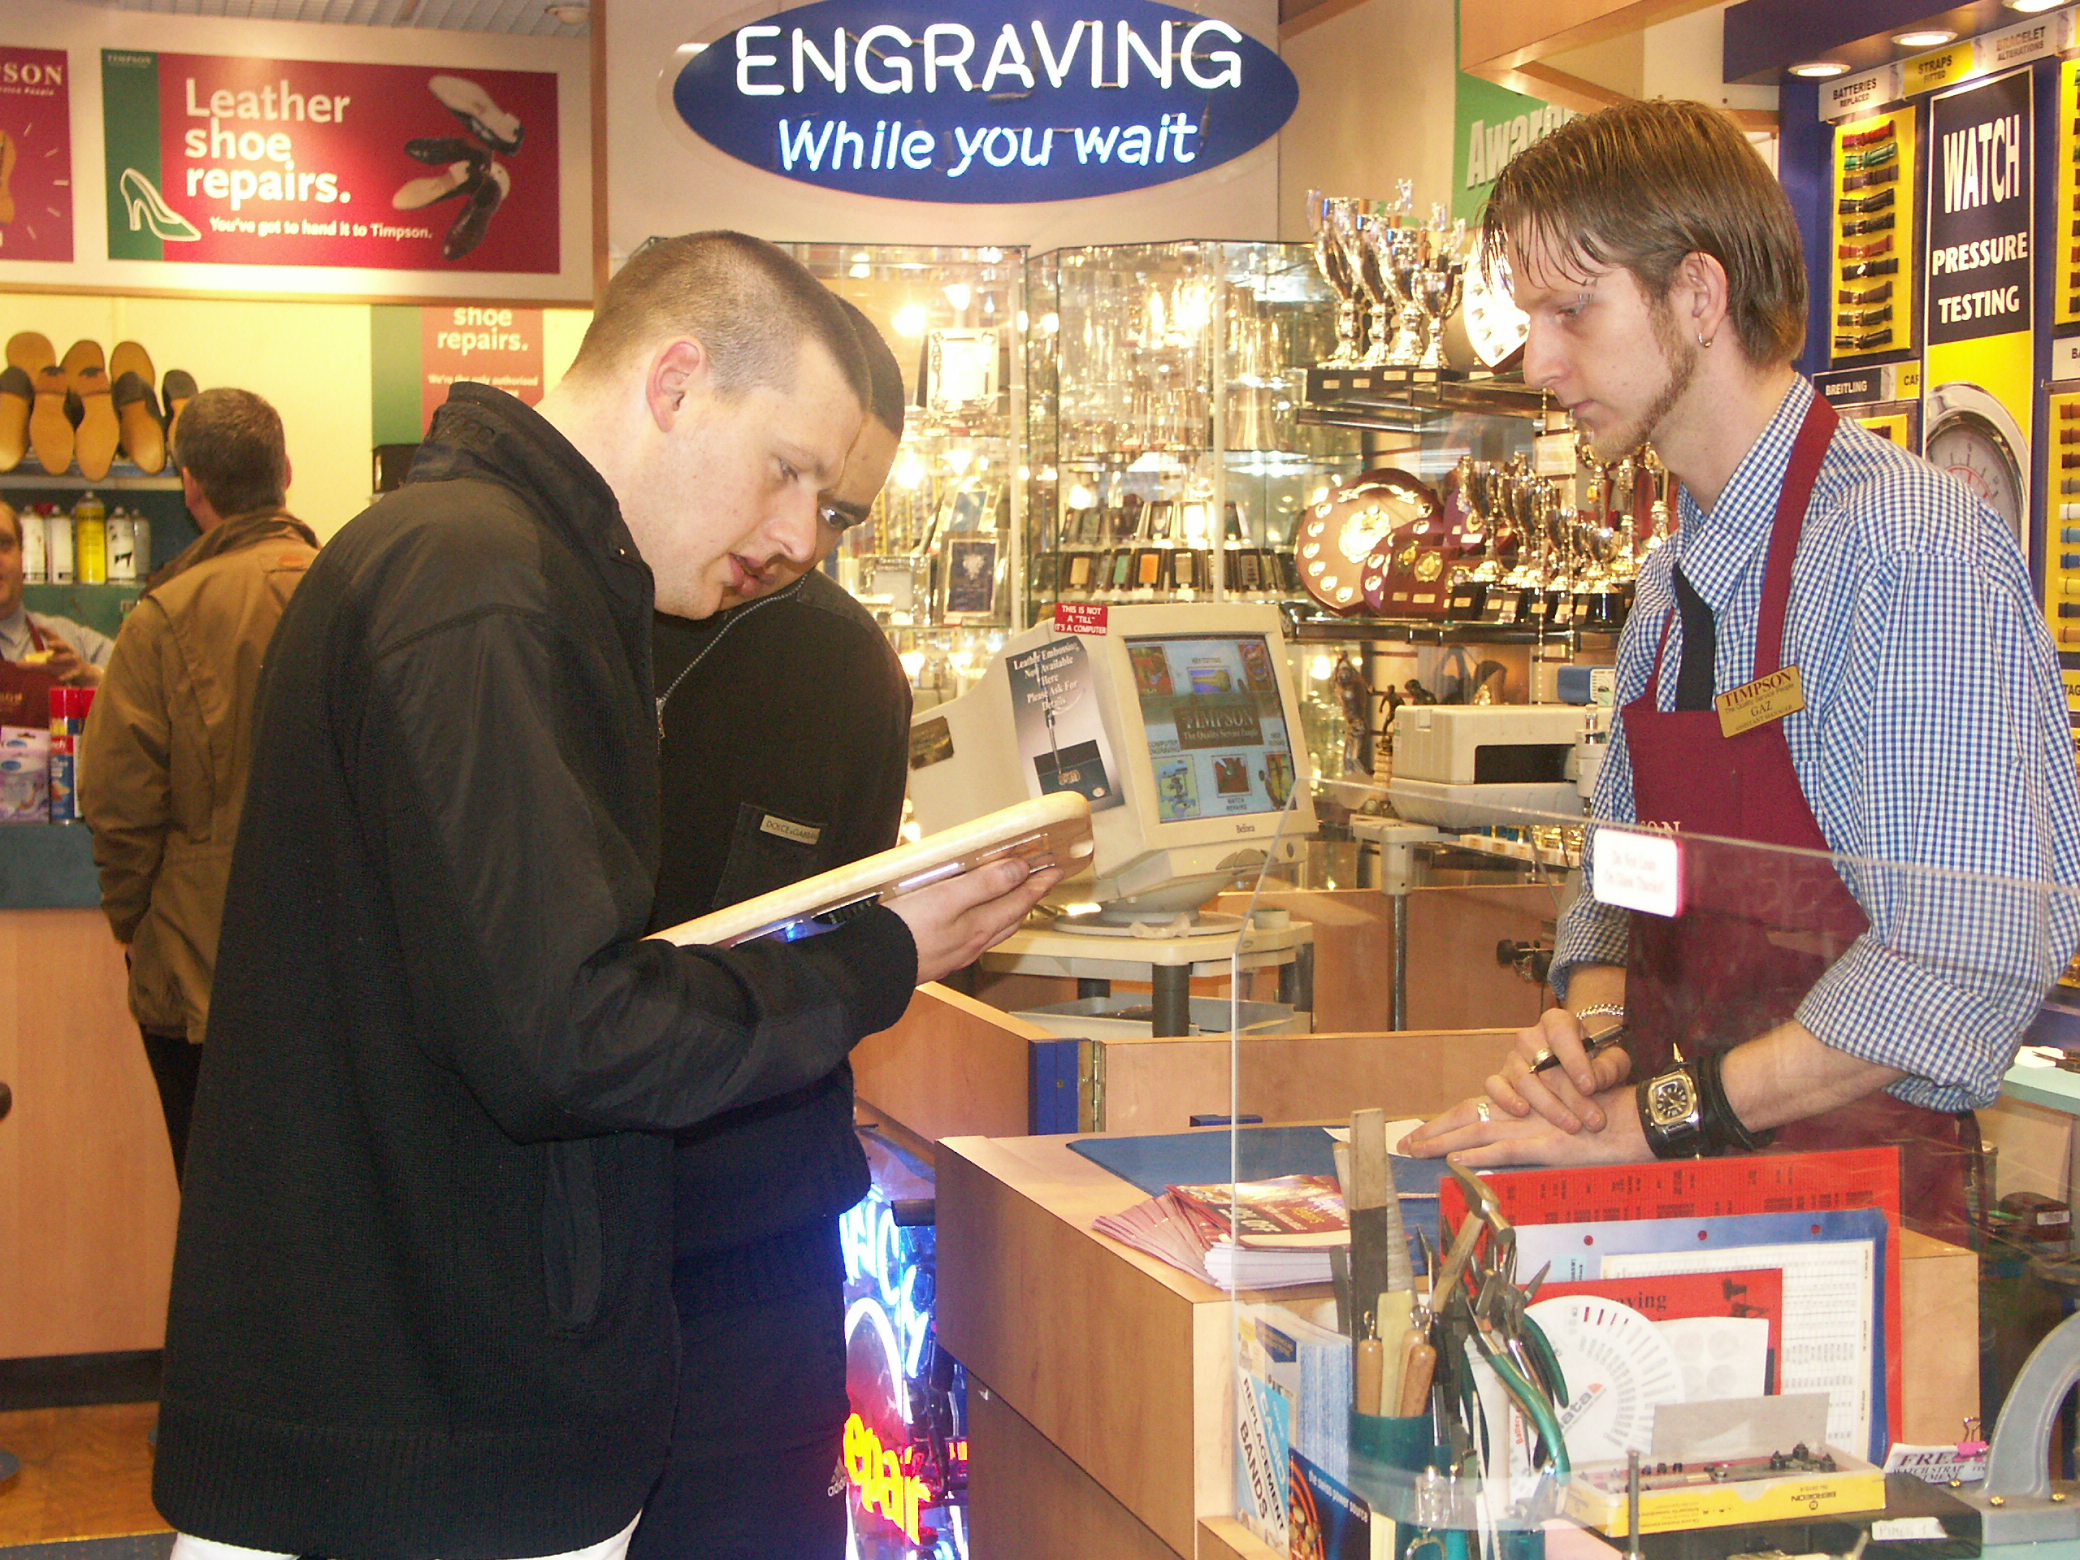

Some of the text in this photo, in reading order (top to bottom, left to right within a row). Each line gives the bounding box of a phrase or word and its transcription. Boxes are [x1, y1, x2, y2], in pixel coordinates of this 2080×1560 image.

[1997, 26, 2046, 51] BRACELET
[736, 20, 1242, 95] ENGRAVING
[1918, 55, 1952, 75] STRAPS
[2, 61, 62, 85] SON
[186, 78, 351, 123] Leather
[1833, 78, 1877, 100] BATTERIES
[1840, 93, 1869, 108] REPLACED
[185, 117, 292, 162] shoe
[779, 113, 1197, 177] While you wait
[1943, 114, 2020, 214] WATCH
[186, 160, 351, 211] repairs.
[209, 216, 433, 240] You've got to hand it to Timpson.
[1932, 231, 2028, 276] PRESSURE
[1938, 285, 2020, 324] TESTING
[453, 307, 513, 327] shoe
[437, 326, 529, 356] repairs.
[1825, 380, 1867, 396] BREITLING
[1062, 605, 1101, 615] THIS IS NOT
[1074, 625, 1106, 634] COMPUTER
[1025, 669, 1039, 679] No
[1050, 683, 1063, 695] Ask
[1065, 680, 1078, 691] For
[1722, 670, 1792, 706] TIMPSON
[1186, 710, 1254, 729] TIMPSON
[1750, 700, 1772, 717] GAZ
[1559, 1391, 1593, 1431] ata
[1243, 1377, 1285, 1531] REPLACEMENT
[1900, 1451, 1955, 1466] FRE
[843, 1413, 931, 1545] epair
[1240, 1421, 1268, 1520] BANDS
[1309, 1469, 1317, 1486] the
[1932, 1465, 1964, 1474] STRAP
[1791, 1491, 1837, 1502] BERGEON
